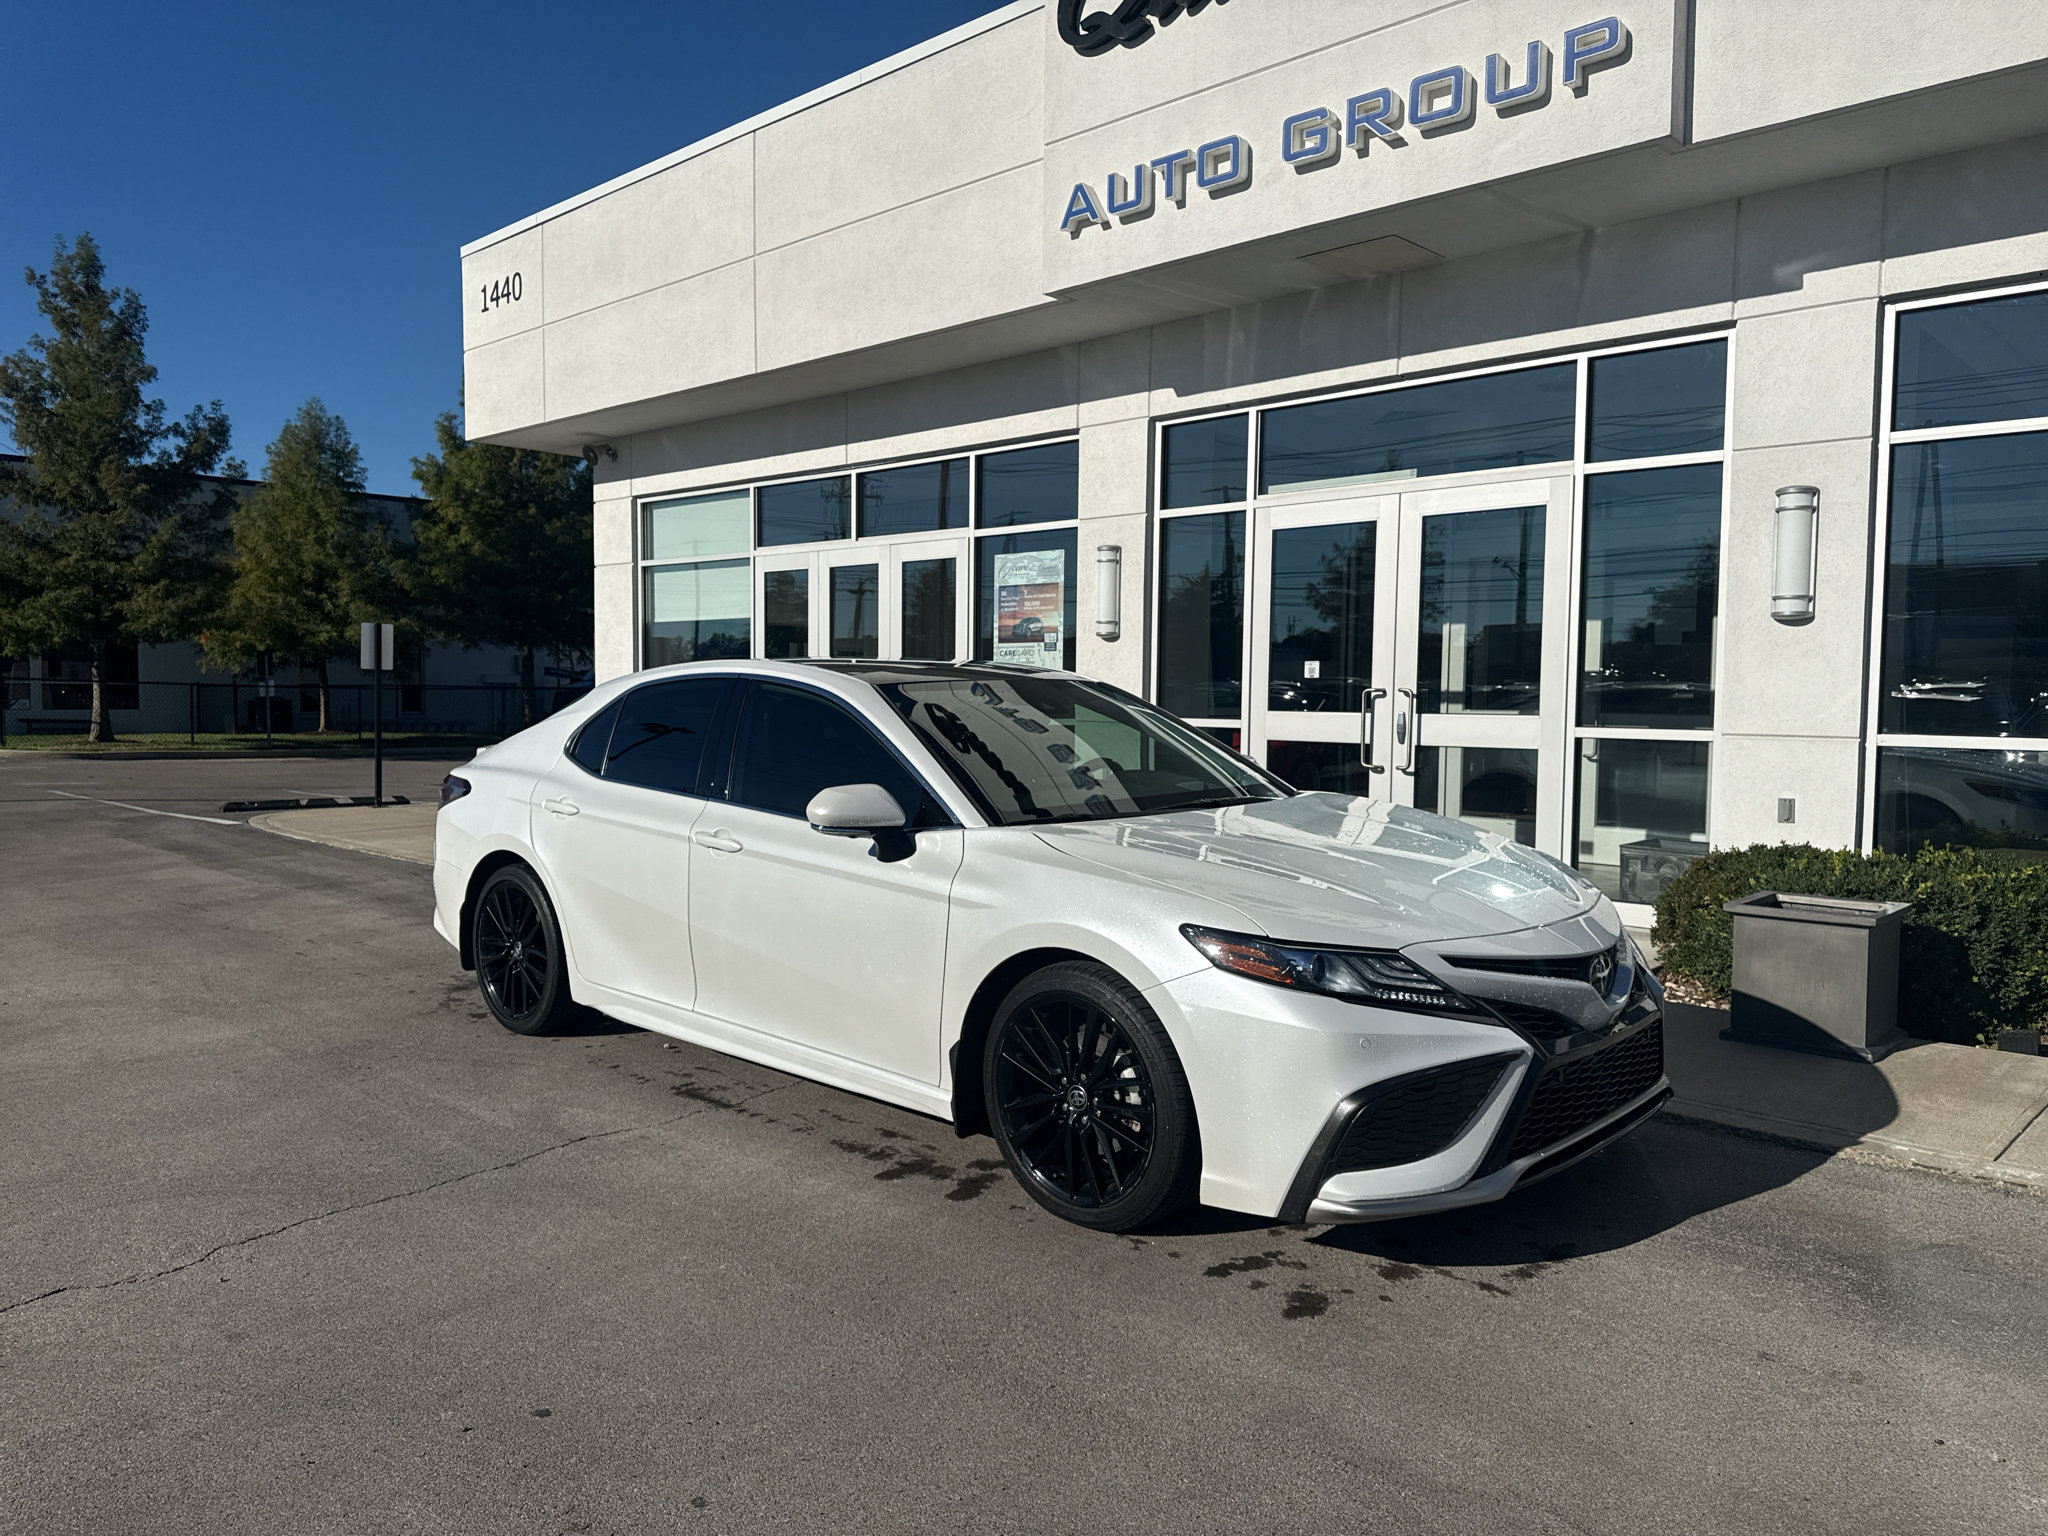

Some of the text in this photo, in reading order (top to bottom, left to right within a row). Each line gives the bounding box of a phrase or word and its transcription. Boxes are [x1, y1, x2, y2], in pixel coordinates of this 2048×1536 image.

[1060, 134, 1249, 234] AUTO
[1281, 15, 1629, 167] GROUP
[481, 272, 522, 313] 1440
[999, 649, 1035, 657] CAREGARD
